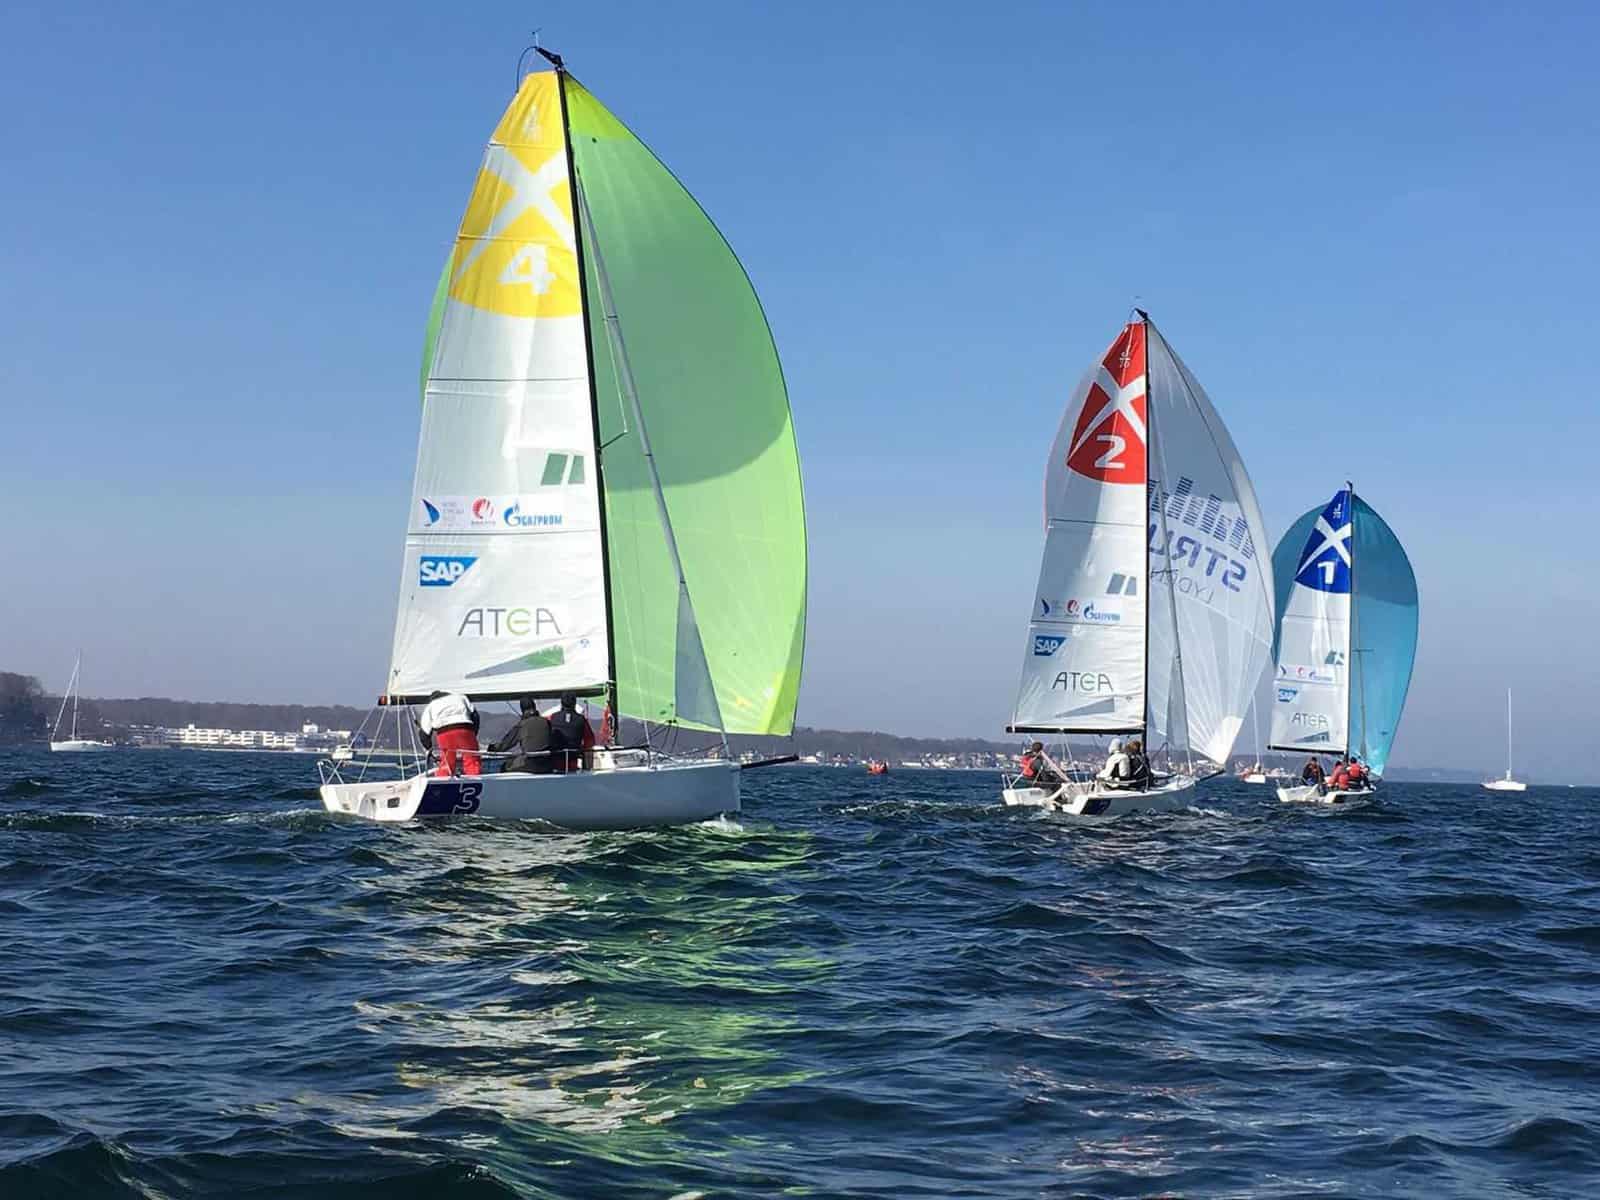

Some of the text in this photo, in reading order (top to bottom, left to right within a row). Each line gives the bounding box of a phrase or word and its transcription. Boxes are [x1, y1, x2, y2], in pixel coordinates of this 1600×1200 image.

[499, 242, 556, 296] 4
[1094, 434, 1126, 470] 2
[420, 560, 464, 581] SAP
[1317, 561, 1336, 585] 1
[457, 607, 561, 638] ATEA
[1035, 639, 1058, 653] SAP
[1052, 671, 1114, 692] ATEA
[452, 782, 484, 815] 3
